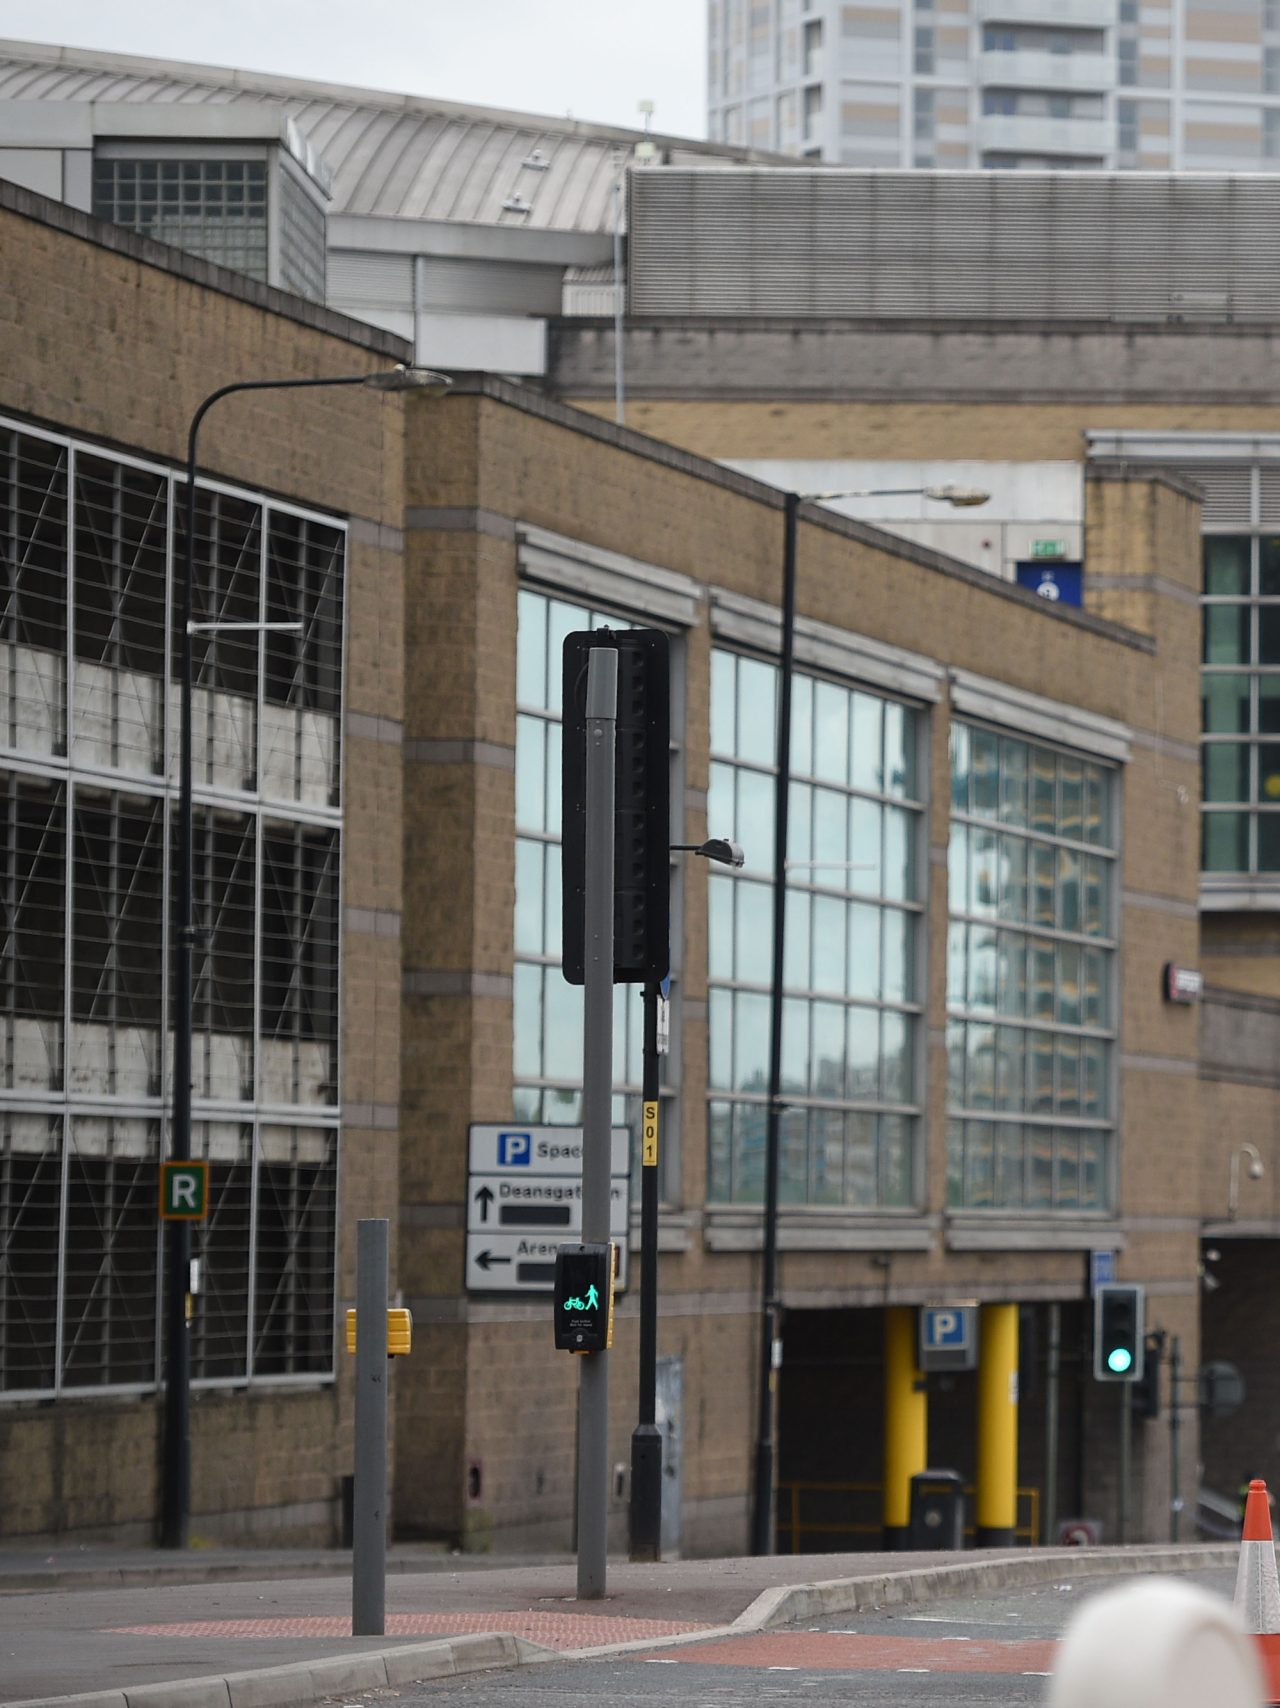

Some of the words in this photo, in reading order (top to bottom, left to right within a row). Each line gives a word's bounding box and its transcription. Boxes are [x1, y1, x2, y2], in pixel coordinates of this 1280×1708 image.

[504, 1135, 527, 1166] P
[537, 1141, 582, 1161] Spac
[171, 1173, 197, 1209] R
[499, 1182, 582, 1201] Deansgat
[517, 1240, 558, 1256] Aren
[933, 1312, 957, 1345] P
